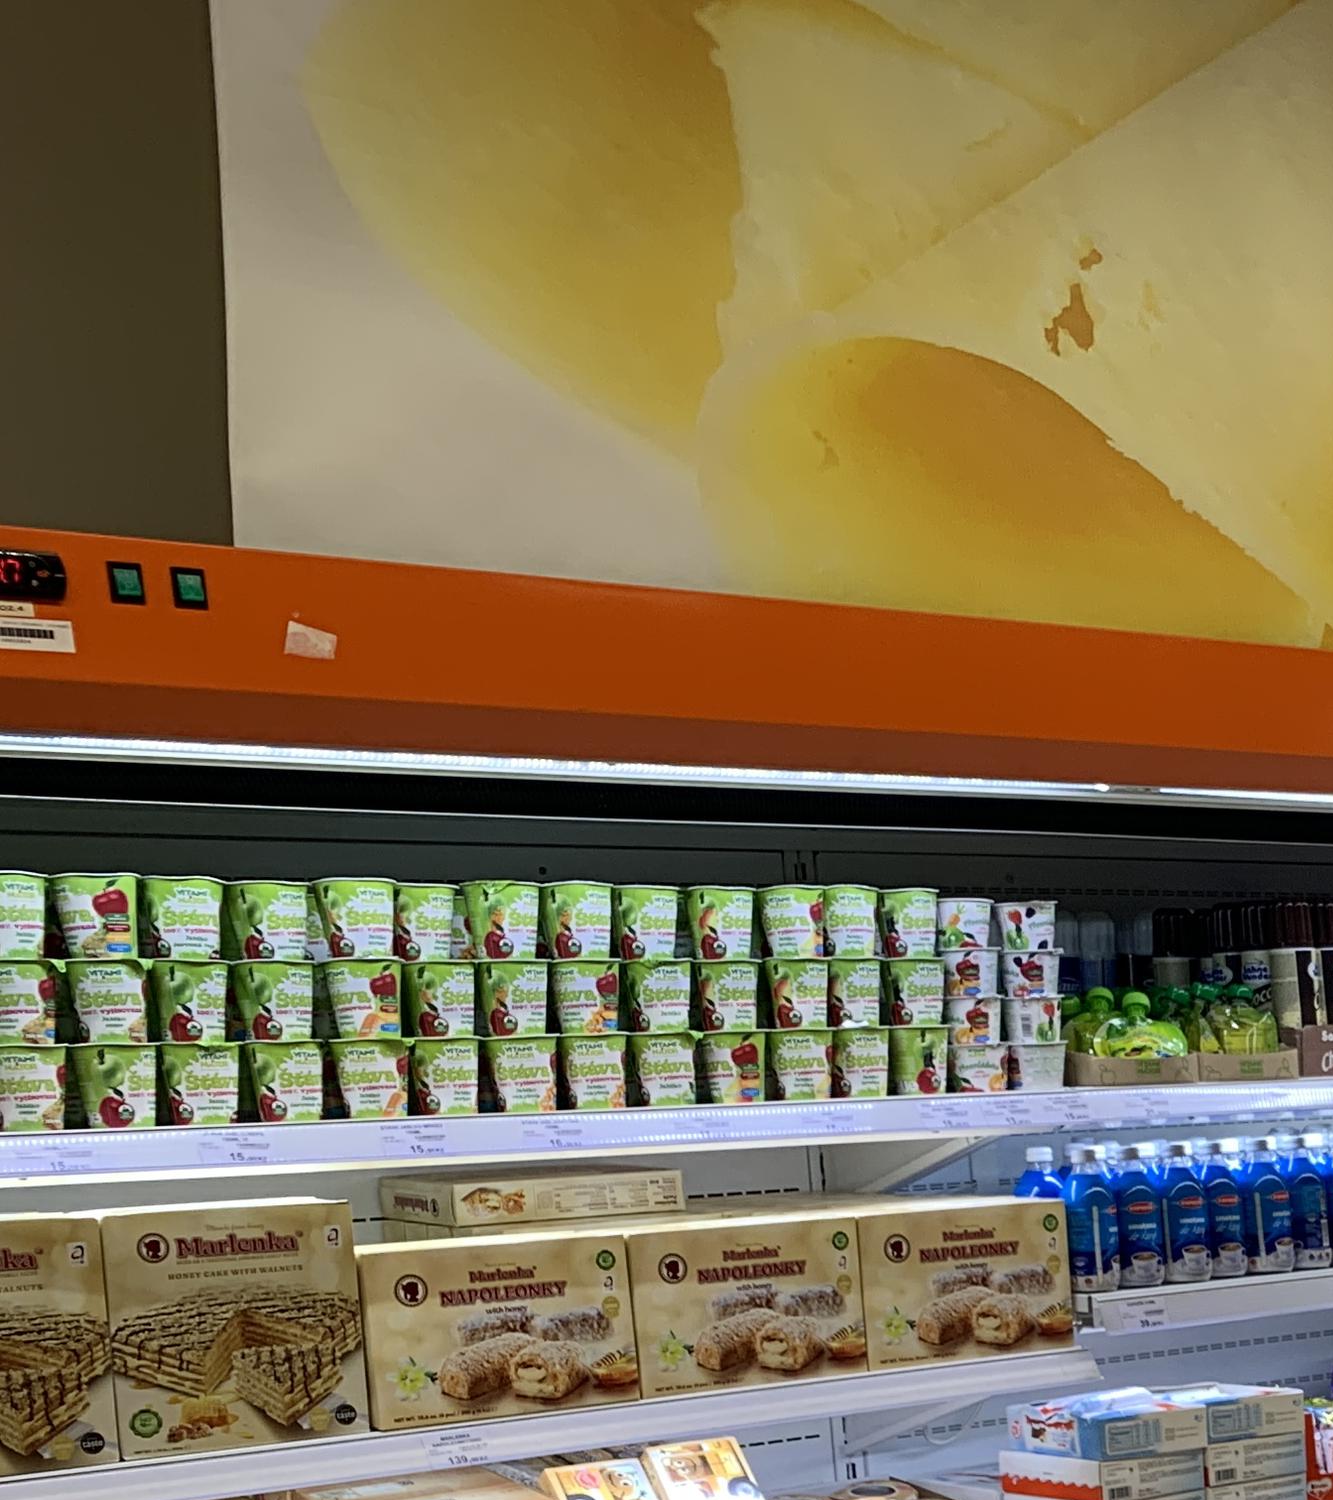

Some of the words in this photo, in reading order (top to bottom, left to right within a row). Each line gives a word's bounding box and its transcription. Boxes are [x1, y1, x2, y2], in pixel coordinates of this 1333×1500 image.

[174, 1229, 300, 1260] Marlenka
[942, 1227, 996, 1243] Marlenka
[722, 1246, 781, 1262] Marlenka
[919, 1240, 1020, 1263] NAPOLEONKY
[167, 1271, 201, 1281] HONEY
[202, 1269, 230, 1279] CAKE
[230, 1267, 258, 1277] WITH
[258, 1263, 304, 1275] WALNUTS
[467, 1266, 536, 1284] Marlenka
[696, 1260, 807, 1284] NAPOLEONKY
[437, 1280, 568, 1308] NAPOLEONKY
